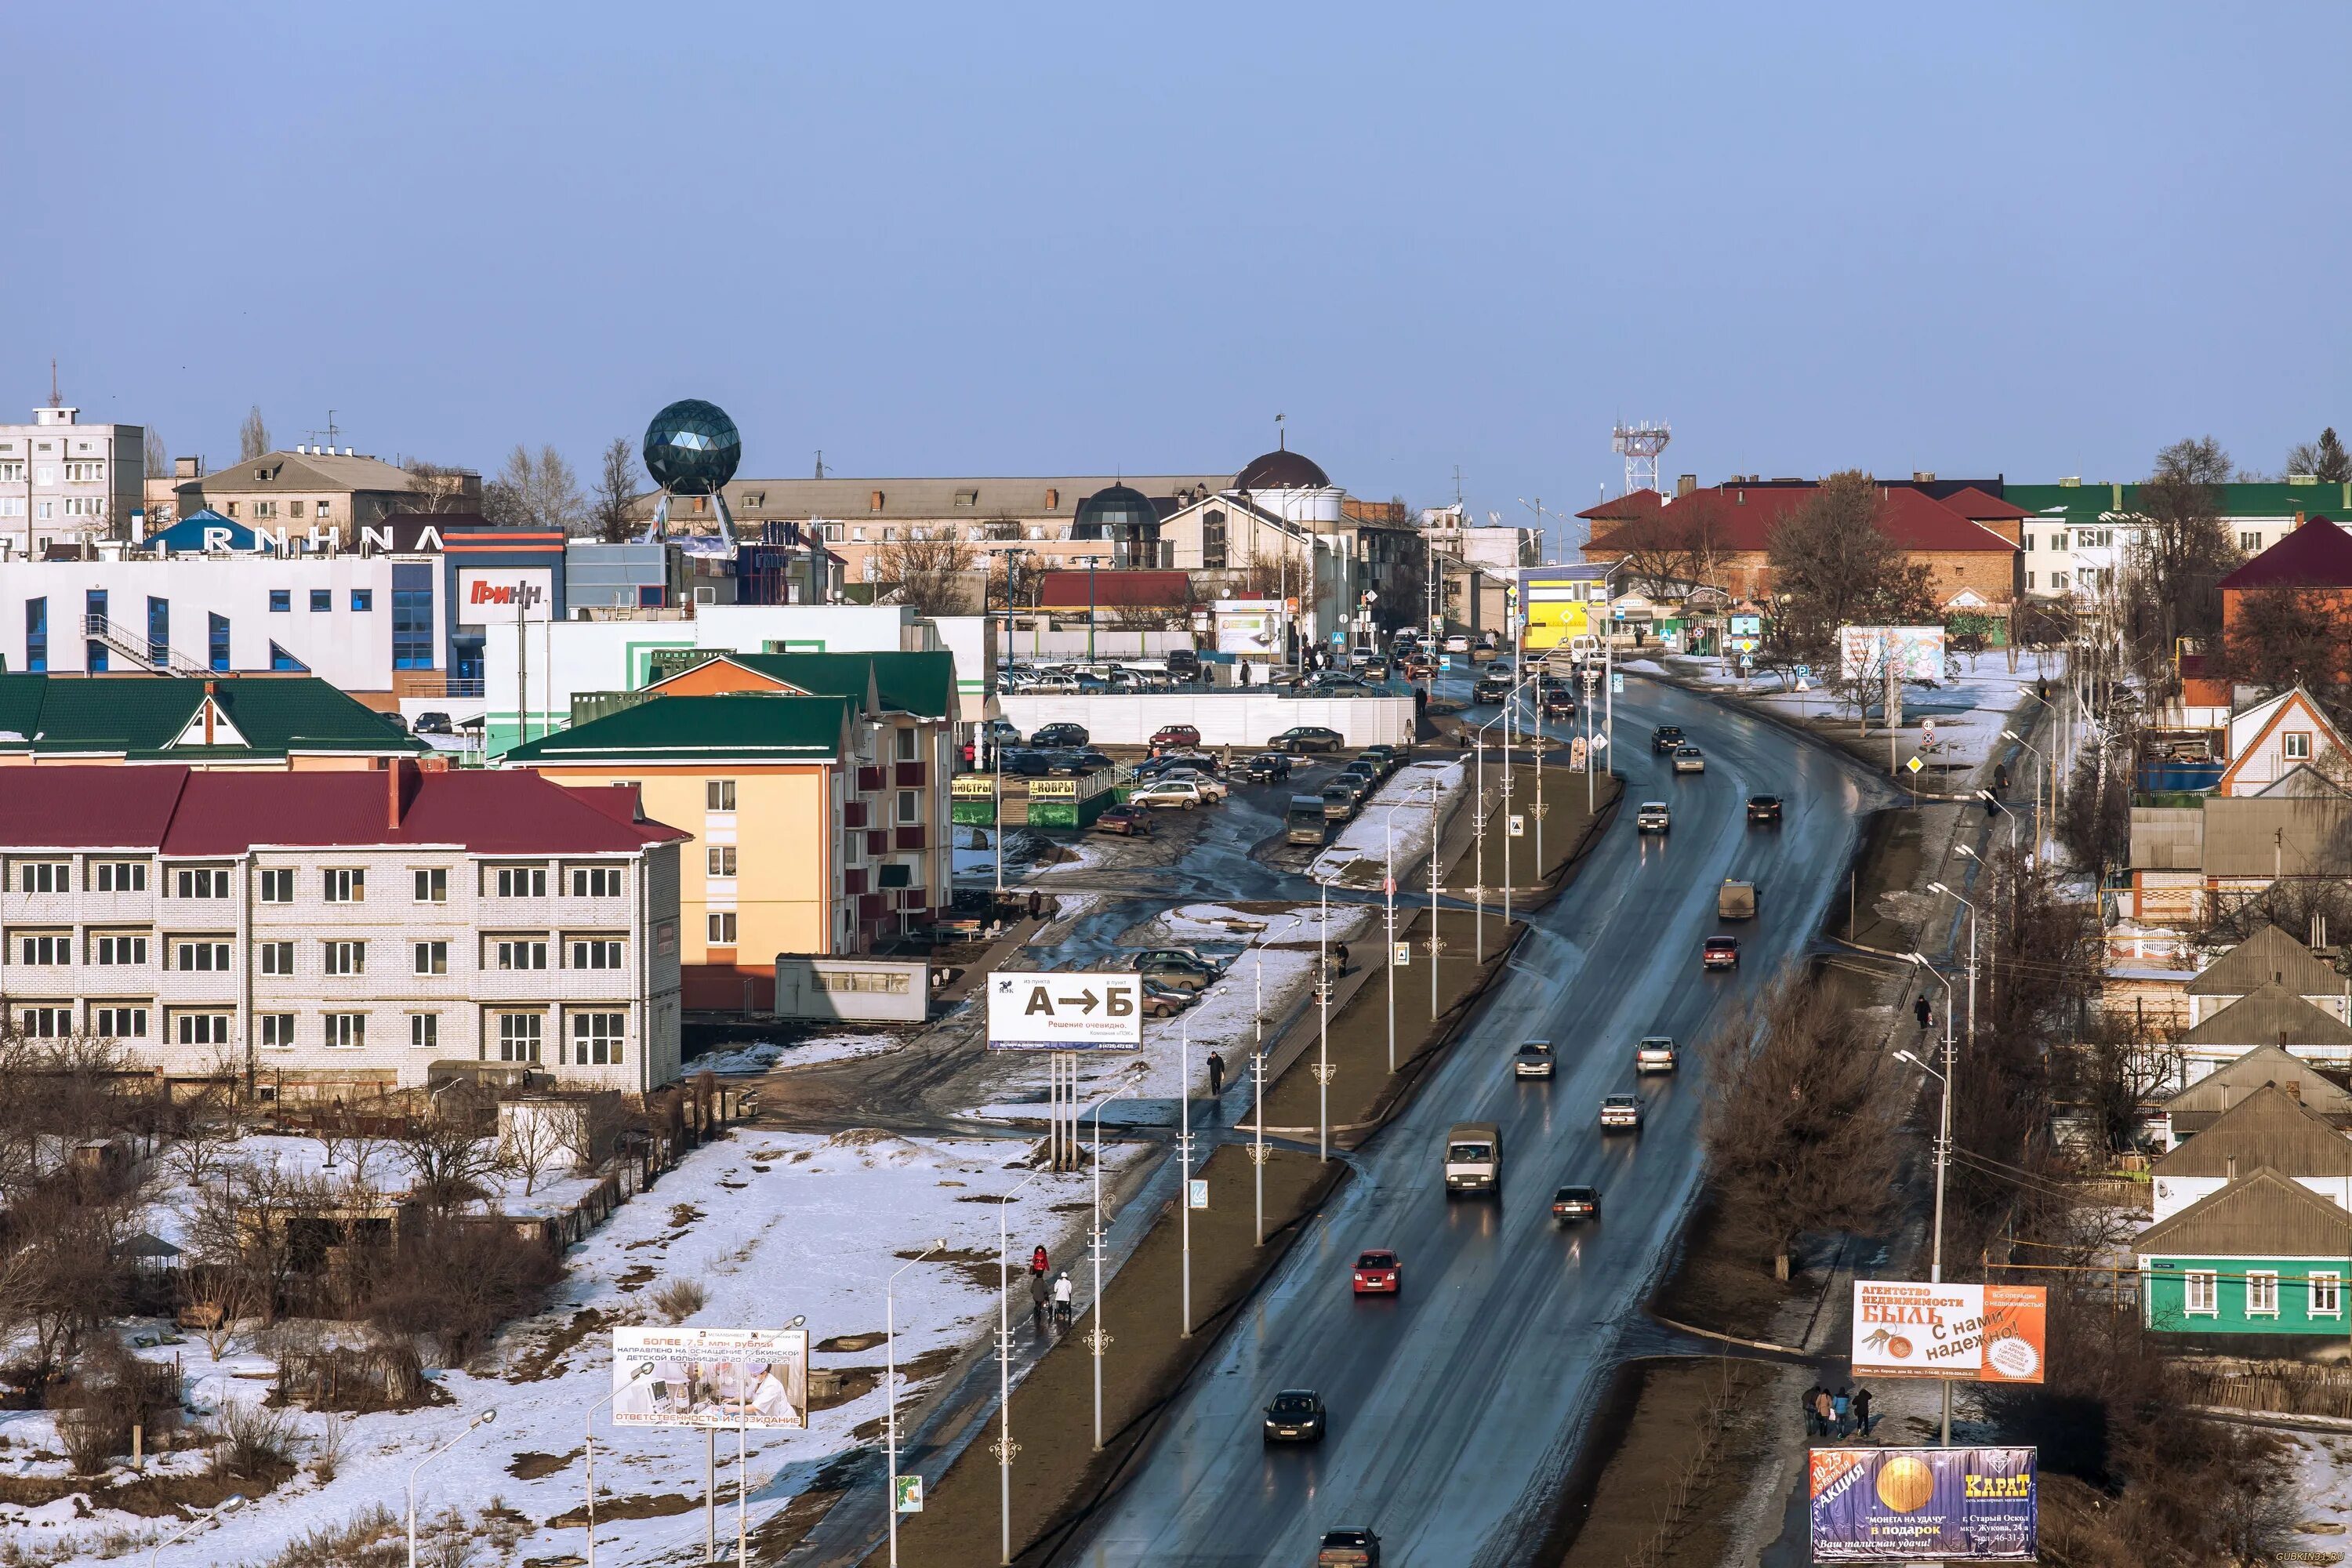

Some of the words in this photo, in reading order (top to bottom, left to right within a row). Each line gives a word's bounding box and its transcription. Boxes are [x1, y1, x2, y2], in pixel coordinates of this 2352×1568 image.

[1038, 782, 1074, 793] КОВРЫ
[1025, 986, 1055, 1015] А
[1107, 987, 1134, 1017] Б
[1862, 1286, 1931, 1296] АГЕНТСТВО
[1862, 1295, 1965, 1307] НЕДВИЖИМОСТИ
[1861, 1305, 1944, 1325] БЫЛЬ
[1932, 1323, 1947, 1340] С
[1952, 1311, 2005, 1335] нами
[643, 1338, 681, 1346] БОЛЕЕ
[686, 1339, 704, 1348] 7,5
[1926, 1320, 2020, 1360] надежно!
[615, 1413, 719, 1422] ОТВЕТСТВЕННОСТЬ
[1813, 1453, 1842, 1481] 10-25
[1817, 1460, 1850, 1490] ФЕВРАЛЯ
[1819, 1463, 1866, 1508] АКЦИЯ
[1969, 1515, 2002, 1523] Старый
[1871, 1526, 1879, 1535] в
[1882, 1526, 1941, 1537] подарок
[1978, 1524, 2012, 1533] Жукова,
[1820, 1539, 1842, 1548] Ваш
[1897, 1538, 1931, 1550] удачи!
